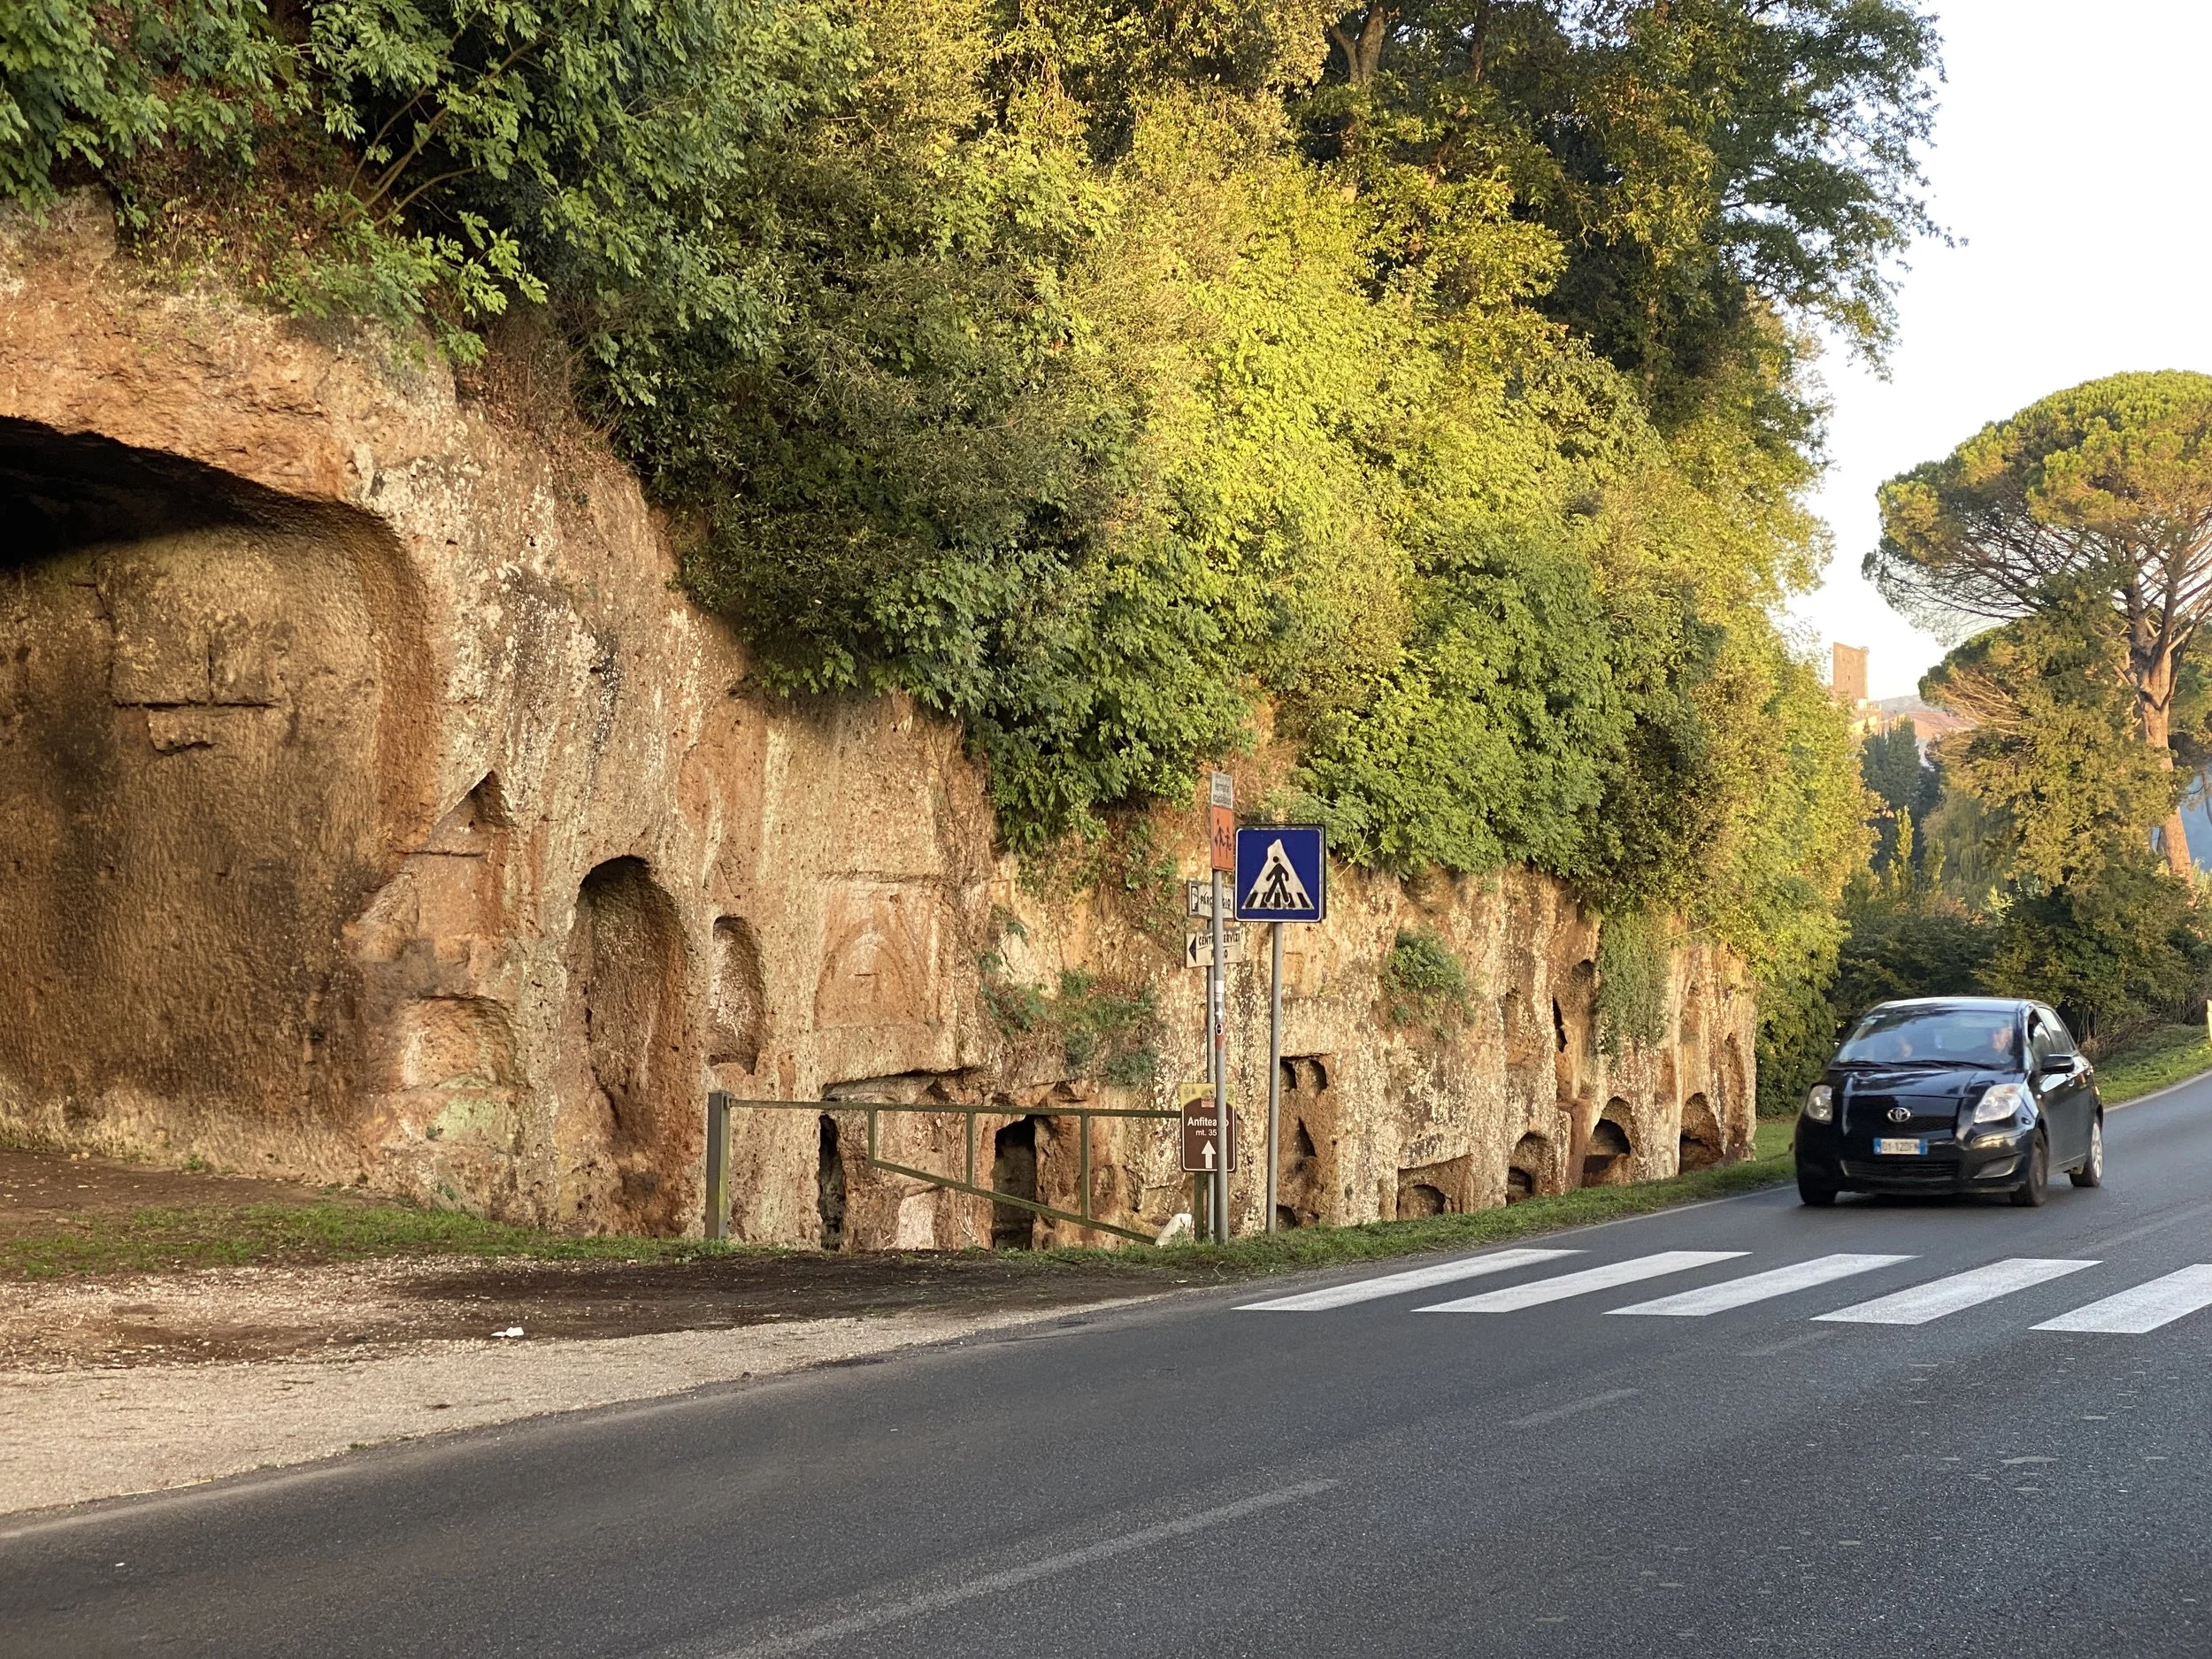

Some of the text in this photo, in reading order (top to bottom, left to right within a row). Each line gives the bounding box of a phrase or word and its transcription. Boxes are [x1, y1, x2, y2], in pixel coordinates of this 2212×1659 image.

[1201, 895, 1231, 907] PARCGIO
[1223, 933, 1240, 943] ERVIZI
[1187, 1117, 1229, 1126] Anfiteao
